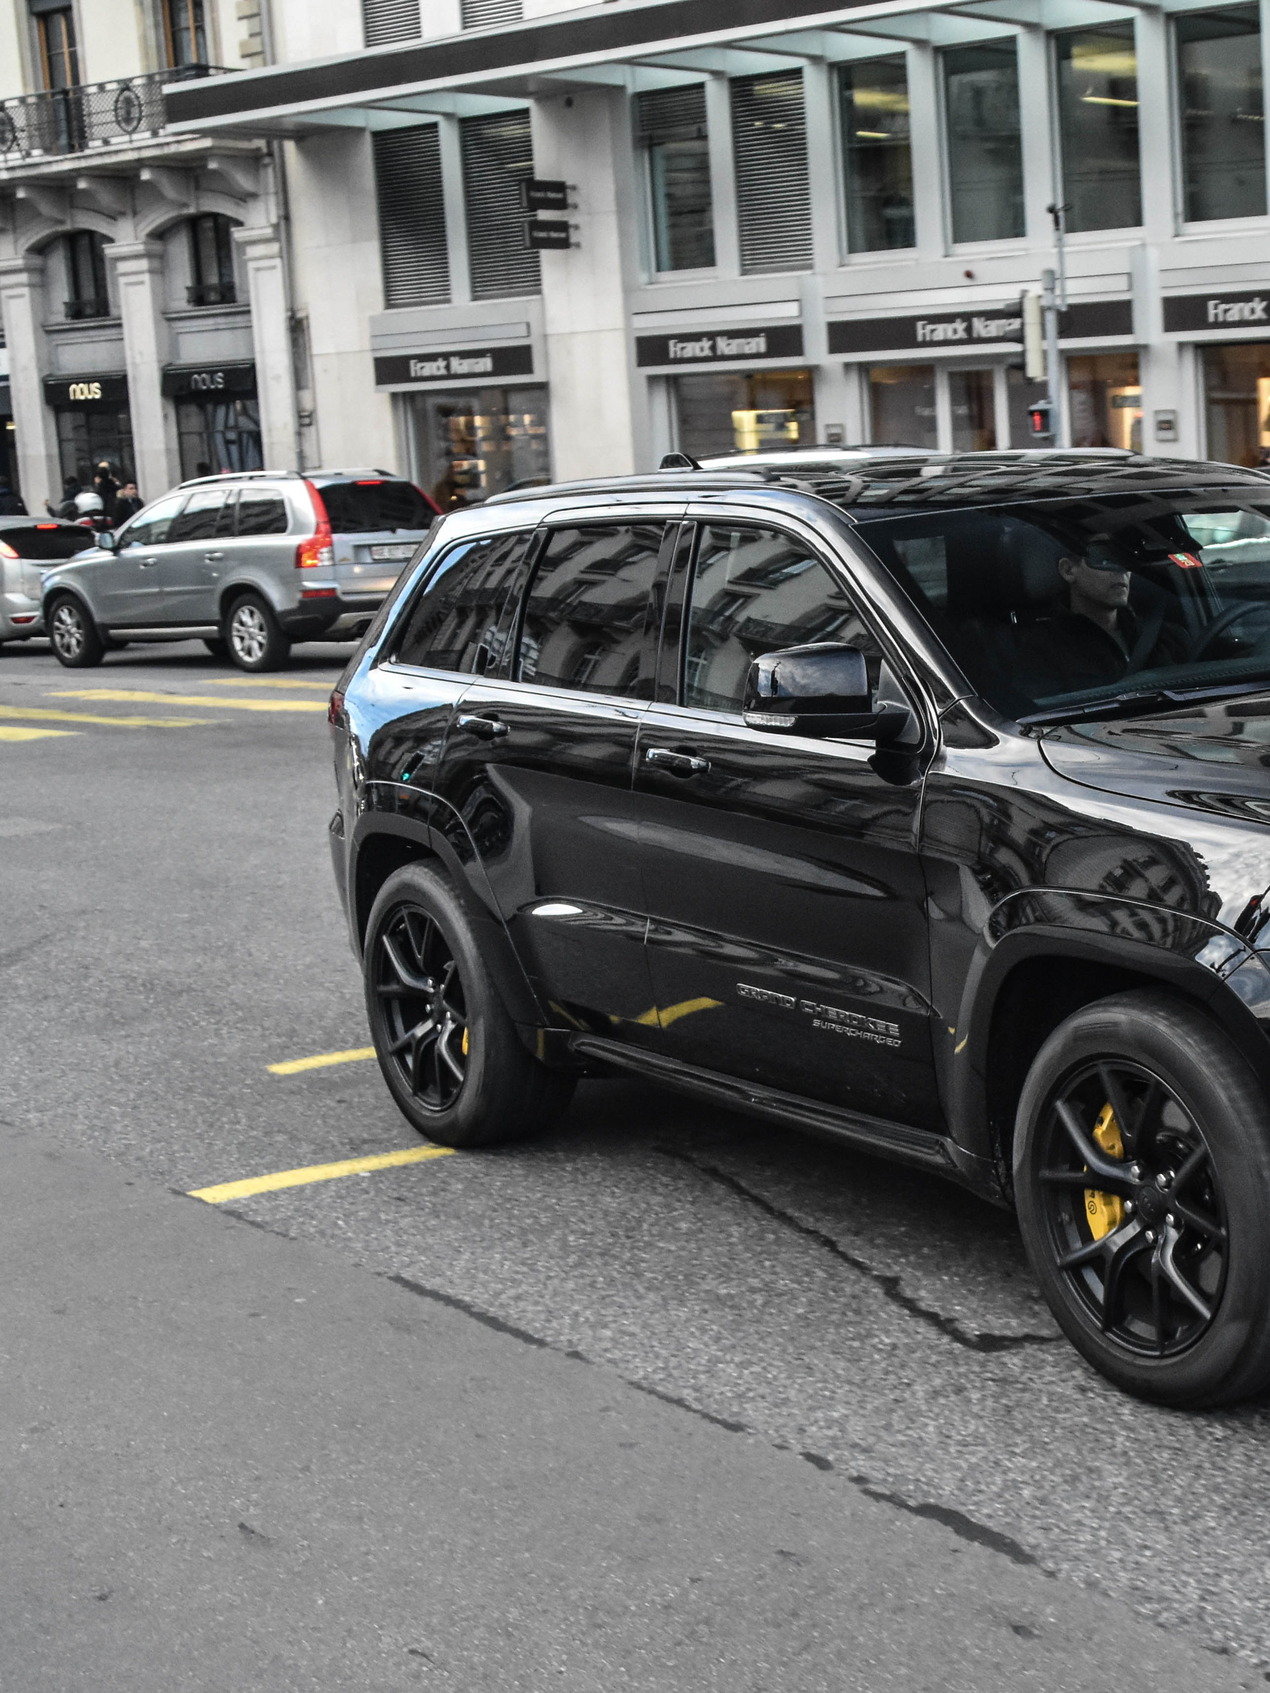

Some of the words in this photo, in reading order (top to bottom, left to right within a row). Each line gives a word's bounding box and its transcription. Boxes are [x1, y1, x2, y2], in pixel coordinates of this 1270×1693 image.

[1207, 298, 1268, 322] Franck
[916, 318, 969, 342] Franck
[668, 337, 714, 359] Franck
[736, 982, 797, 1009] GRAND
[801, 999, 900, 1037] CHEROKEE
[812, 1018, 902, 1048] SUPERCHARGED
